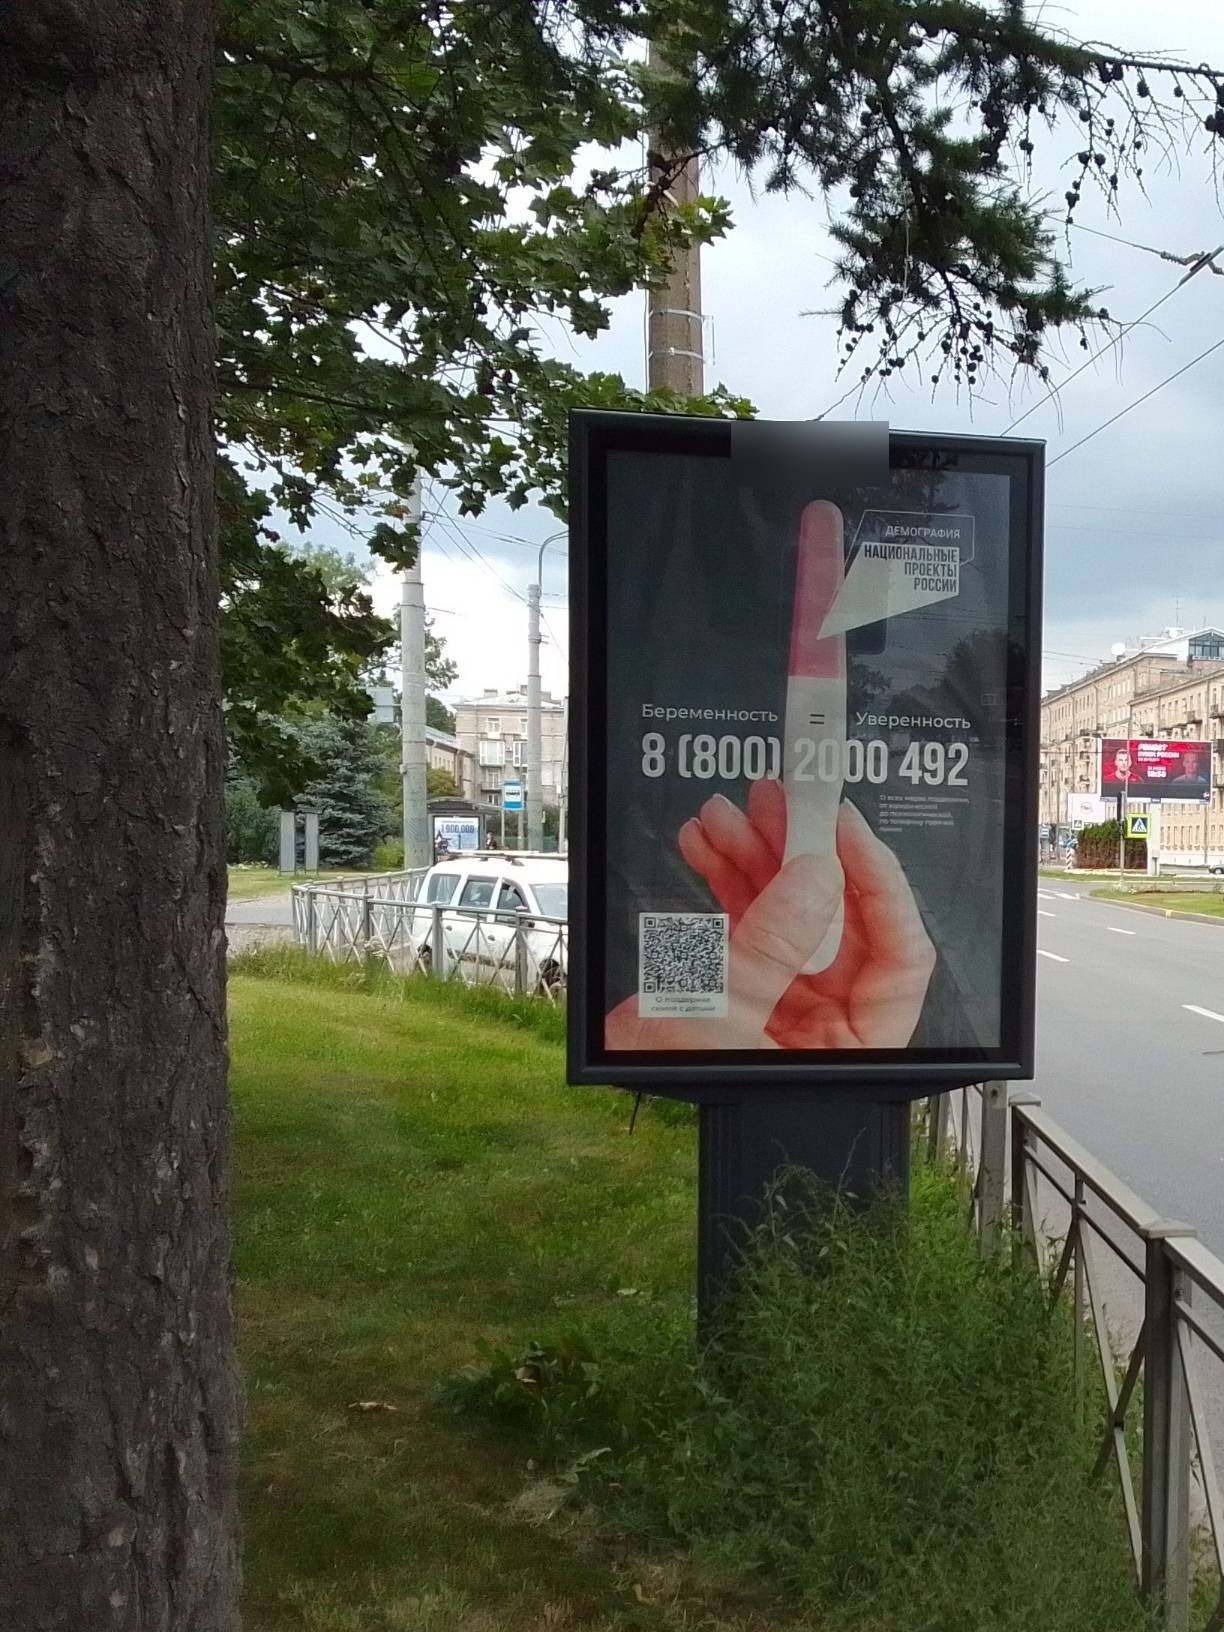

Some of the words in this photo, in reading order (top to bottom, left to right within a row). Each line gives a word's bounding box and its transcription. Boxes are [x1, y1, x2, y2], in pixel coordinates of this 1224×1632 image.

[885, 525, 961, 539] ДЕМОГРАФИЯ
[864, 543, 958, 563] НАЦИОНАЛЬНЫЕ
[904, 561, 957, 577] ПРОЕКТЫ
[913, 577, 957, 593] РОССИИ
[641, 704, 778, 722] Беременность
[856, 712, 971, 729] Уверенность
[641, 732, 666, 778] 8
[678, 734, 782, 780] (800)
[793, 738, 888, 783] 2000
[899, 741, 969, 786] 492
